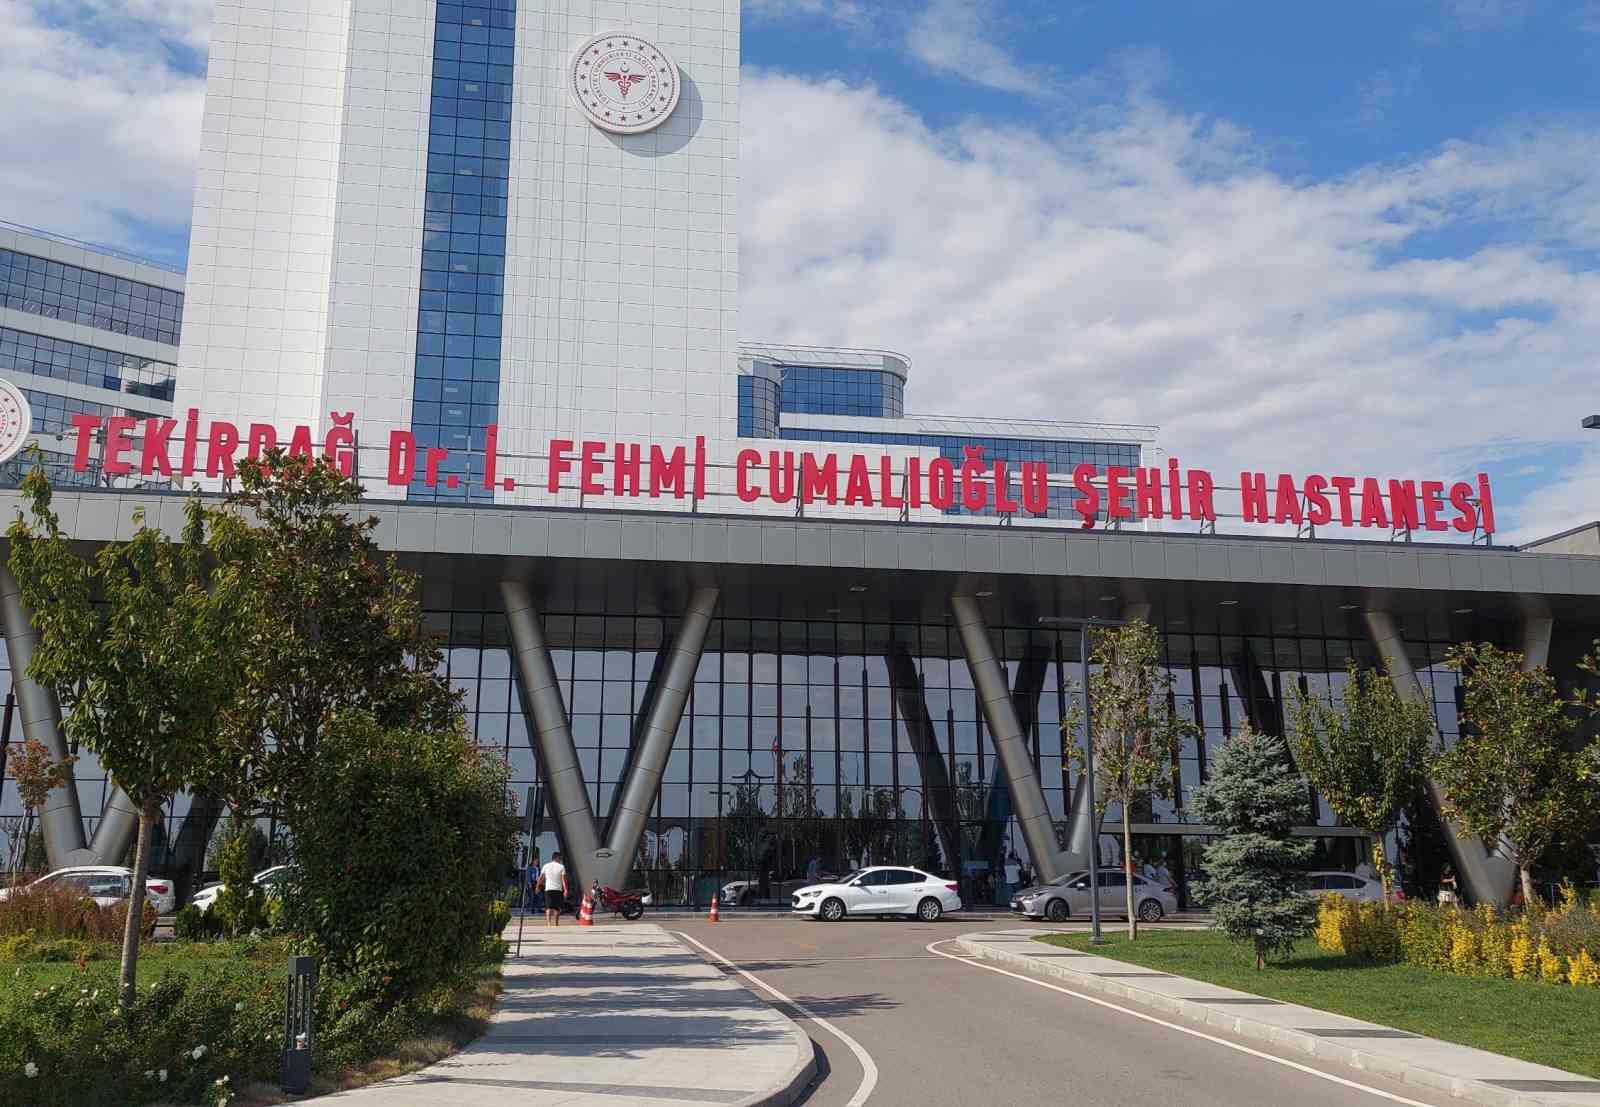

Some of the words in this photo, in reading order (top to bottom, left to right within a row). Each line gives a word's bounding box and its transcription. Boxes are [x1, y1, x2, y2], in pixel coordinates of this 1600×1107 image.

[71, 407, 355, 481] TEKİRDAĞ
[386, 428, 459, 489] Dr.
[483, 424, 517, 491] İ.
[547, 435, 705, 501] FEHMİ
[735, 445, 1049, 514] CUMALIOĞLU
[1072, 458, 1217, 530] ŞEHİR
[1238, 471, 1495, 534] HASTANESİ
